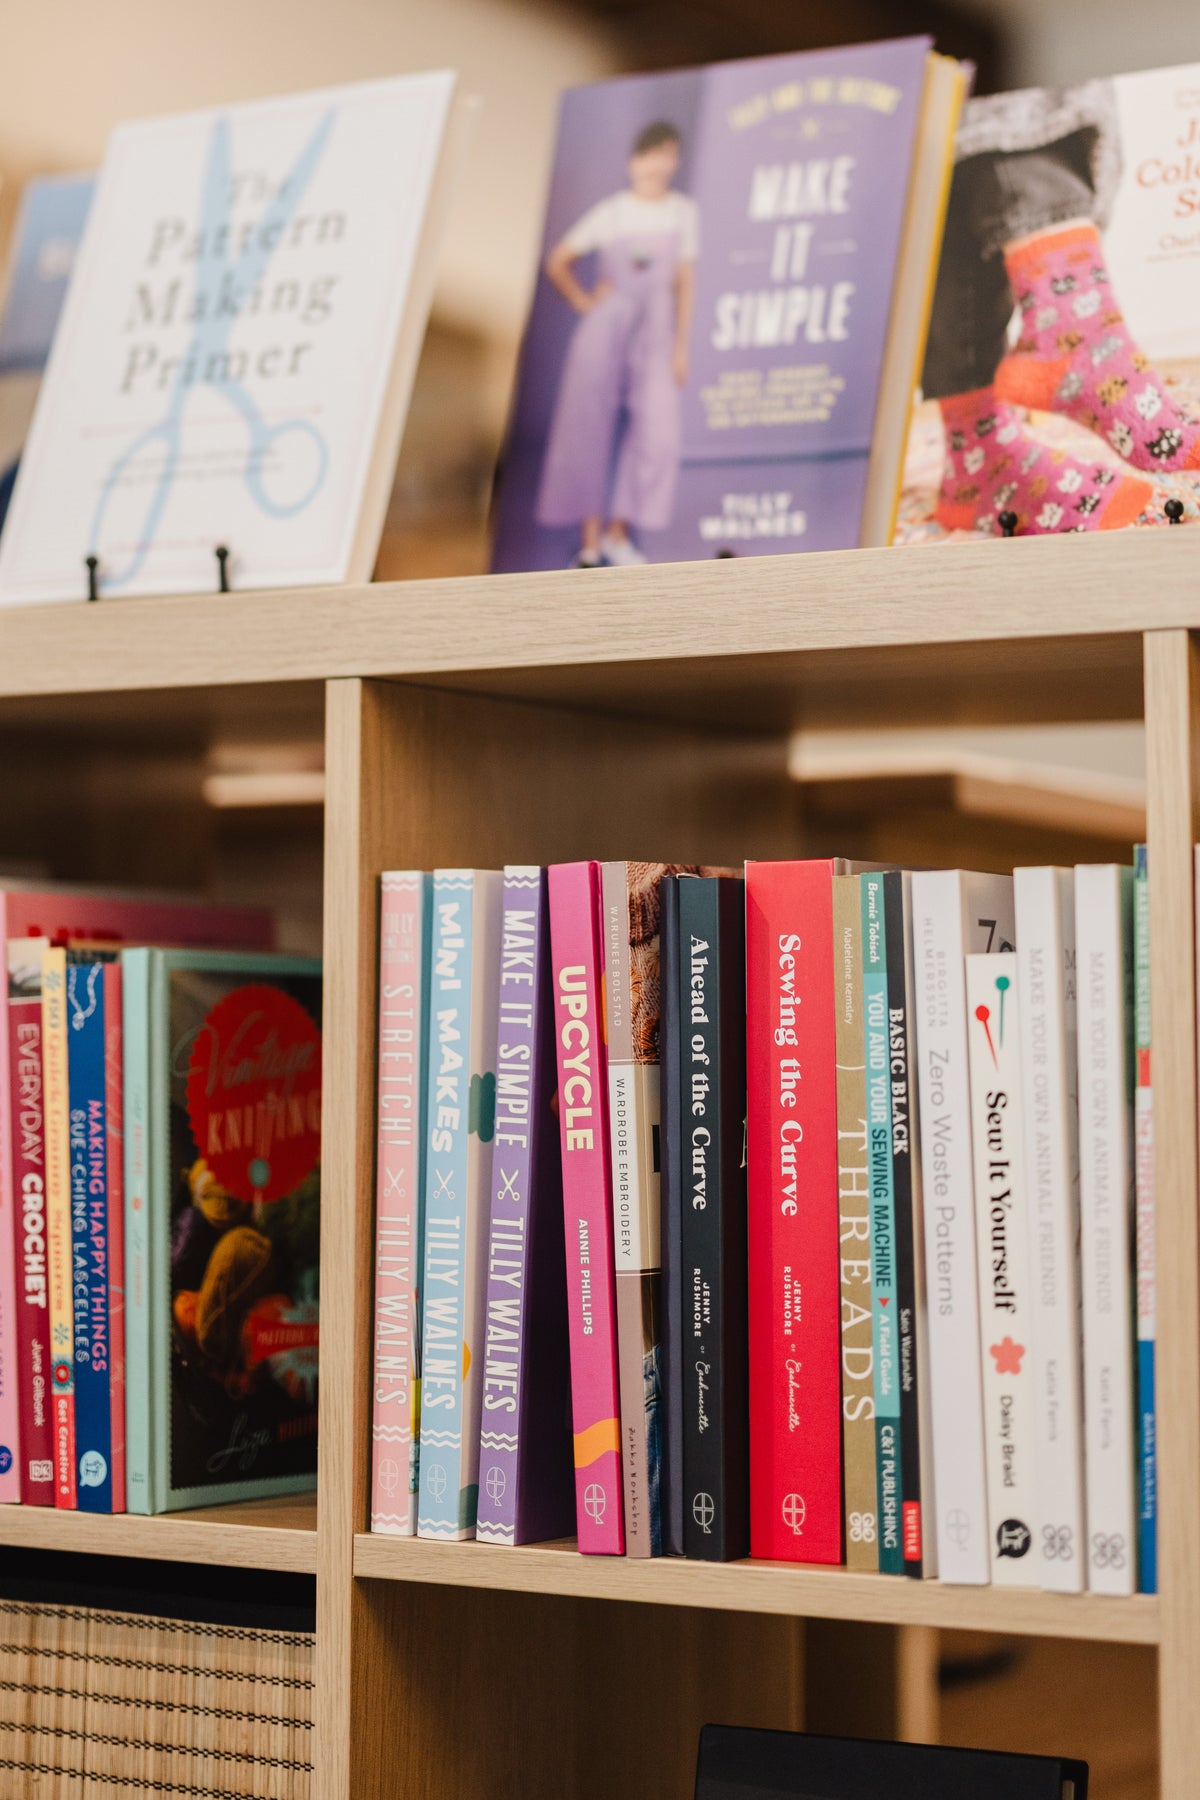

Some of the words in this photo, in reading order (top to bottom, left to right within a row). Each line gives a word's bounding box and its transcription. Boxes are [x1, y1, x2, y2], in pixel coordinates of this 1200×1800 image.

[1175, 117, 1200, 148] J
[748, 155, 857, 222] MAKE
[1173, 178, 1200, 219] S
[145, 208, 347, 268] Pattern
[769, 219, 816, 283] IT
[122, 270, 338, 333] Making
[711, 281, 856, 351] SIMPLE
[119, 341, 312, 396] Primer
[867, 882, 879, 920] Bernie
[434, 902, 465, 990] MINI
[501, 910, 536, 987] MAKE
[609, 905, 620, 966] WARUNEE
[843, 927, 853, 980] Madeleine
[869, 921, 881, 964] Tobisch
[612, 971, 622, 1027] BOLSTAD
[690, 934, 709, 1025] Ahead
[774, 934, 801, 1047] Sewing
[844, 982, 854, 1025] Kemsley
[868, 991, 884, 1028] YOU
[500, 1002, 533, 1028] IT
[889, 1008, 906, 1074] BASIC
[381, 984, 415, 1146] STRETCH!
[431, 1008, 464, 1153] MAKES
[558, 965, 594, 1151] UPCYCLE
[691, 1034, 710, 1066] of
[780, 1057, 802, 1108] the
[869, 1032, 886, 1070] AND
[928, 1050, 949, 1107] Zero
[17, 1023, 43, 1165] EVERYDAY
[495, 1043, 531, 1149] SIMPLE
[616, 1078, 628, 1157] WARDROBE
[691, 1072, 710, 1117] the
[870, 1075, 887, 1123] YOUR
[891, 1081, 909, 1155] BLACK
[986, 1091, 1008, 1152] Sew
[70, 1109, 88, 1232] SUE-CHING
[87, 1100, 105, 1195] MAKING
[691, 1126, 711, 1211] Curve
[780, 1120, 803, 1217] Curve
[872, 1129, 889, 1198] SEWING
[932, 1114, 952, 1197] Waste
[989, 1161, 1010, 1181] It
[21, 1173, 46, 1308] CROCHET
[90, 1201, 106, 1277] HAPPY
[578, 1218, 590, 1265] ANNIE
[618, 1163, 631, 1257] EMBROIDERY
[377, 1214, 411, 1282] TILLY
[426, 1215, 460, 1286] TILLY
[490, 1217, 524, 1289] TILLY
[837, 1118, 877, 1422] THREADS
[874, 1205, 891, 1287] MACHINE
[935, 1206, 956, 1316] Patterns
[990, 1188, 1016, 1314] Yourself
[73, 1242, 90, 1363] LASCELLES
[91, 1284, 107, 1372] THINGS
[580, 1269, 593, 1336] PHILLIPS
[693, 1268, 702, 1337] RUSHMORE
[702, 1282, 711, 1324] JENNY
[783, 1266, 792, 1336] RUSHMORE
[793, 1280, 802, 1322] JENNY
[31, 1338, 43, 1376] June
[375, 1294, 409, 1405] WALNES
[423, 1297, 458, 1410] WALNES
[484, 1299, 521, 1413] WALNES
[880, 1327, 891, 1358] Field
[58, 1400, 67, 1422] Get
[880, 1359, 893, 1396] Guide
[881, 1425, 894, 1456] C&T
[999, 1395, 1013, 1438] Daisy
[59, 1426, 69, 1482] Creative
[1003, 1445, 1015, 1488] Braid
[882, 1460, 897, 1548] PUBLISHING
[906, 1508, 918, 1553] TUTTLE
